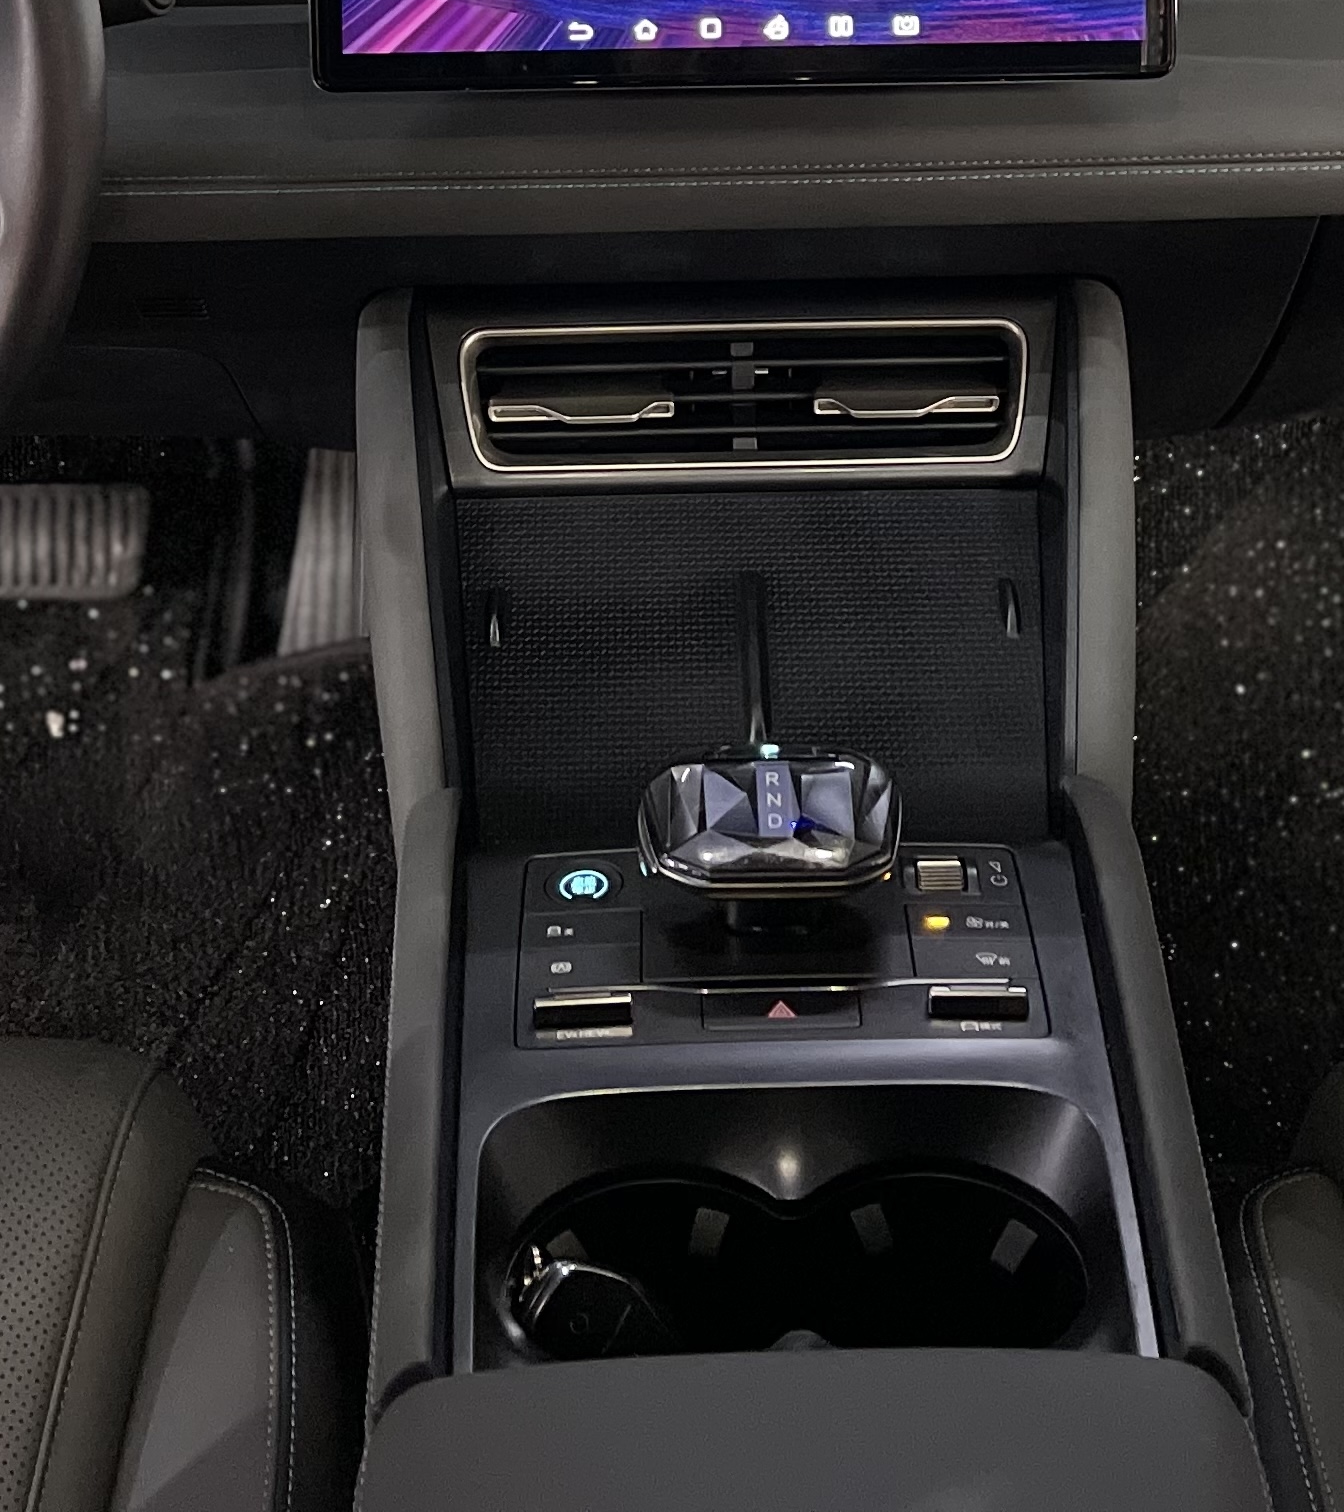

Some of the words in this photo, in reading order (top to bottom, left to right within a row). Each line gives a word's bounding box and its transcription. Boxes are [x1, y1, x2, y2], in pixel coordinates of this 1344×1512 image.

[765, 771, 780, 787] R
[766, 792, 782, 807] N
[768, 813, 783, 829] D
